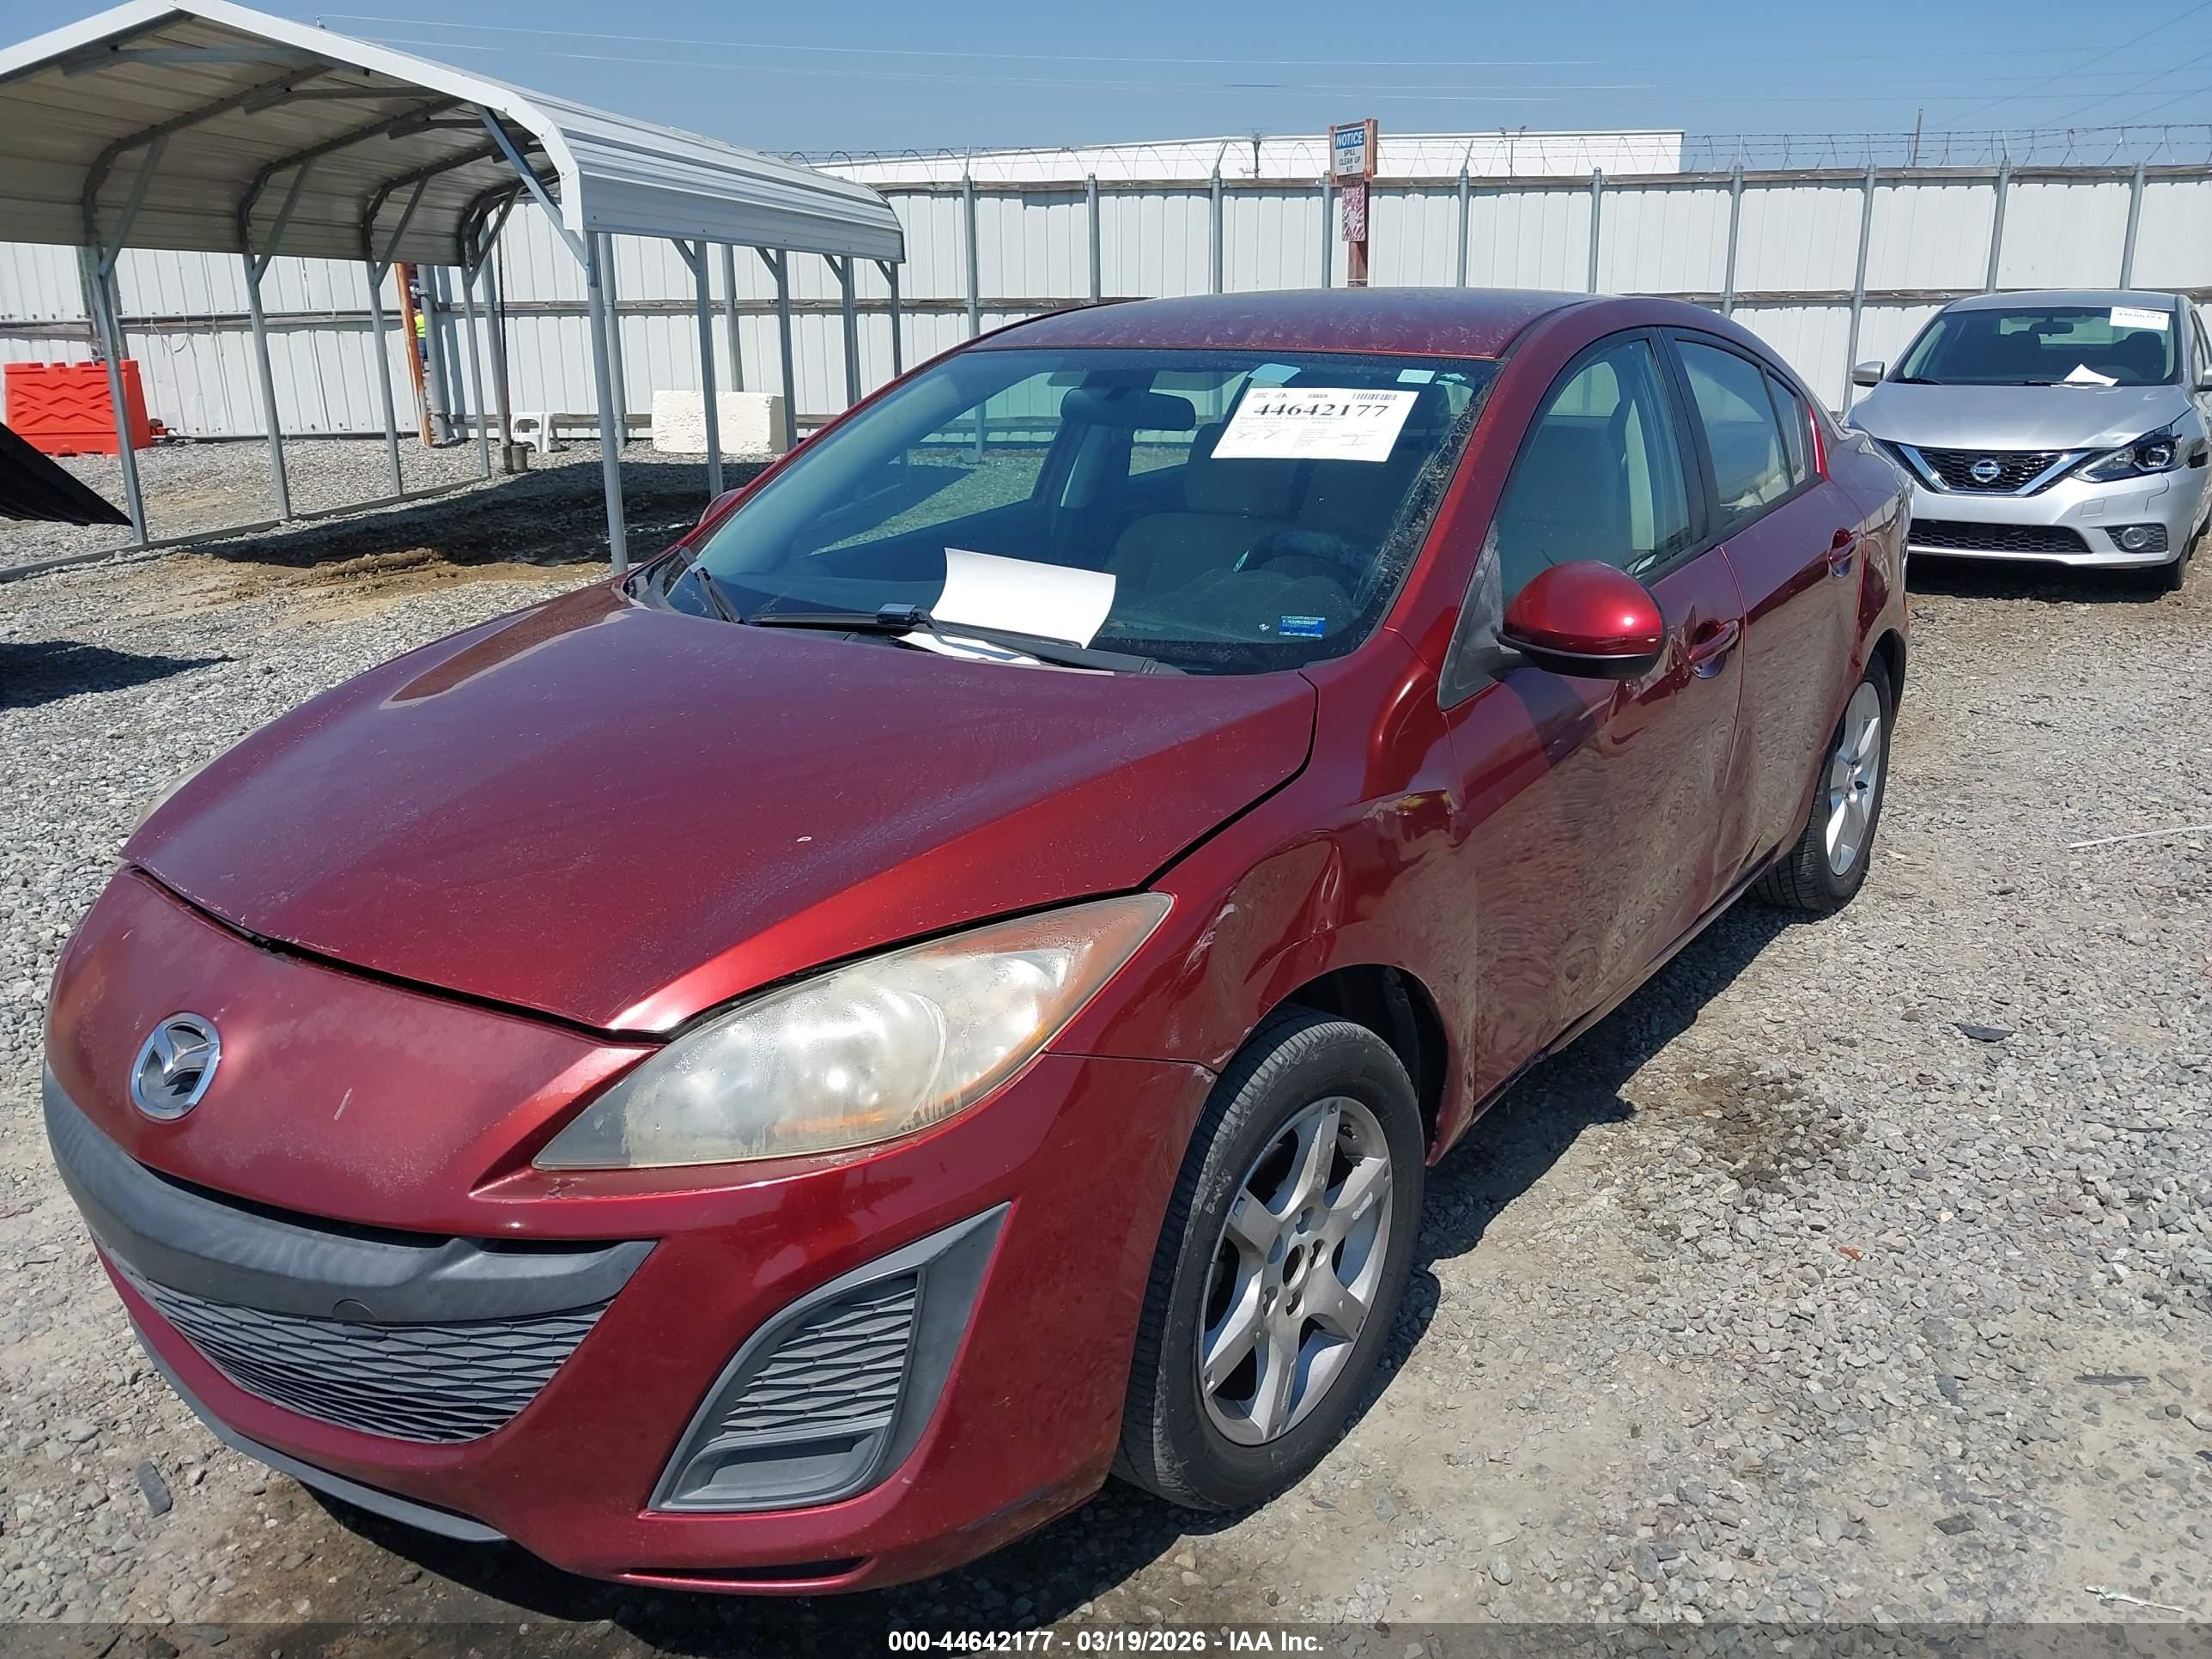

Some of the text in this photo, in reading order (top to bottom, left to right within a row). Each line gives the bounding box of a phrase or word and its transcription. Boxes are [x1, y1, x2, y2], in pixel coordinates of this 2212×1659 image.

[1336, 131, 1364, 148] NOTICE
[1344, 149, 1356, 157] SPILL
[1339, 155, 1361, 166] CLEAN UP
[1253, 403, 1389, 417] 44642177
